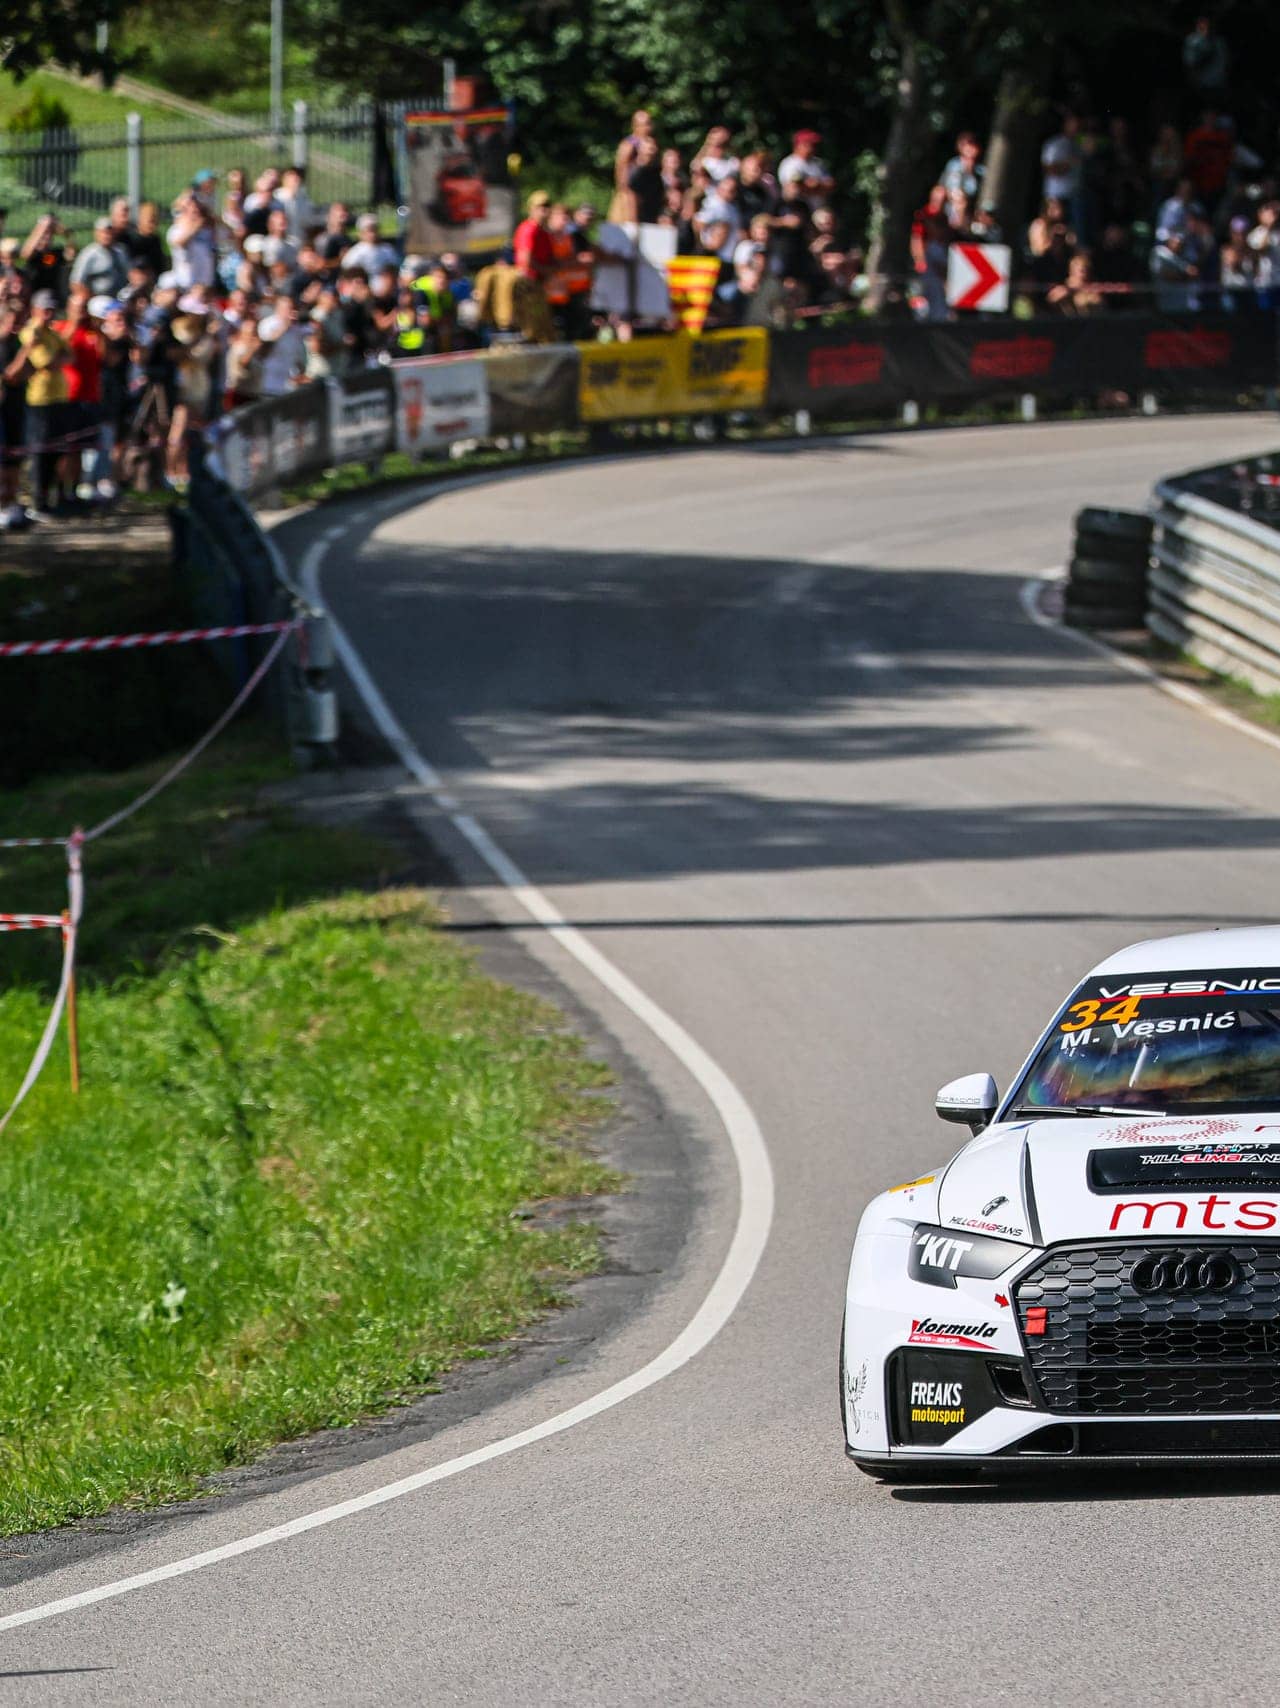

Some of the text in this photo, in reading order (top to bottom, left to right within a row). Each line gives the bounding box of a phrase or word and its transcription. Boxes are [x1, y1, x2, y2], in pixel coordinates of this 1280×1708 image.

[1060, 995, 1142, 1032] 34
[1060, 1011, 1236, 1050] M. Vesnić
[1109, 1195, 1278, 1231] mts
[916, 1318, 999, 1338] formula
[911, 1382, 963, 1406] FREAKS
[911, 1407, 965, 1425] motorsport
